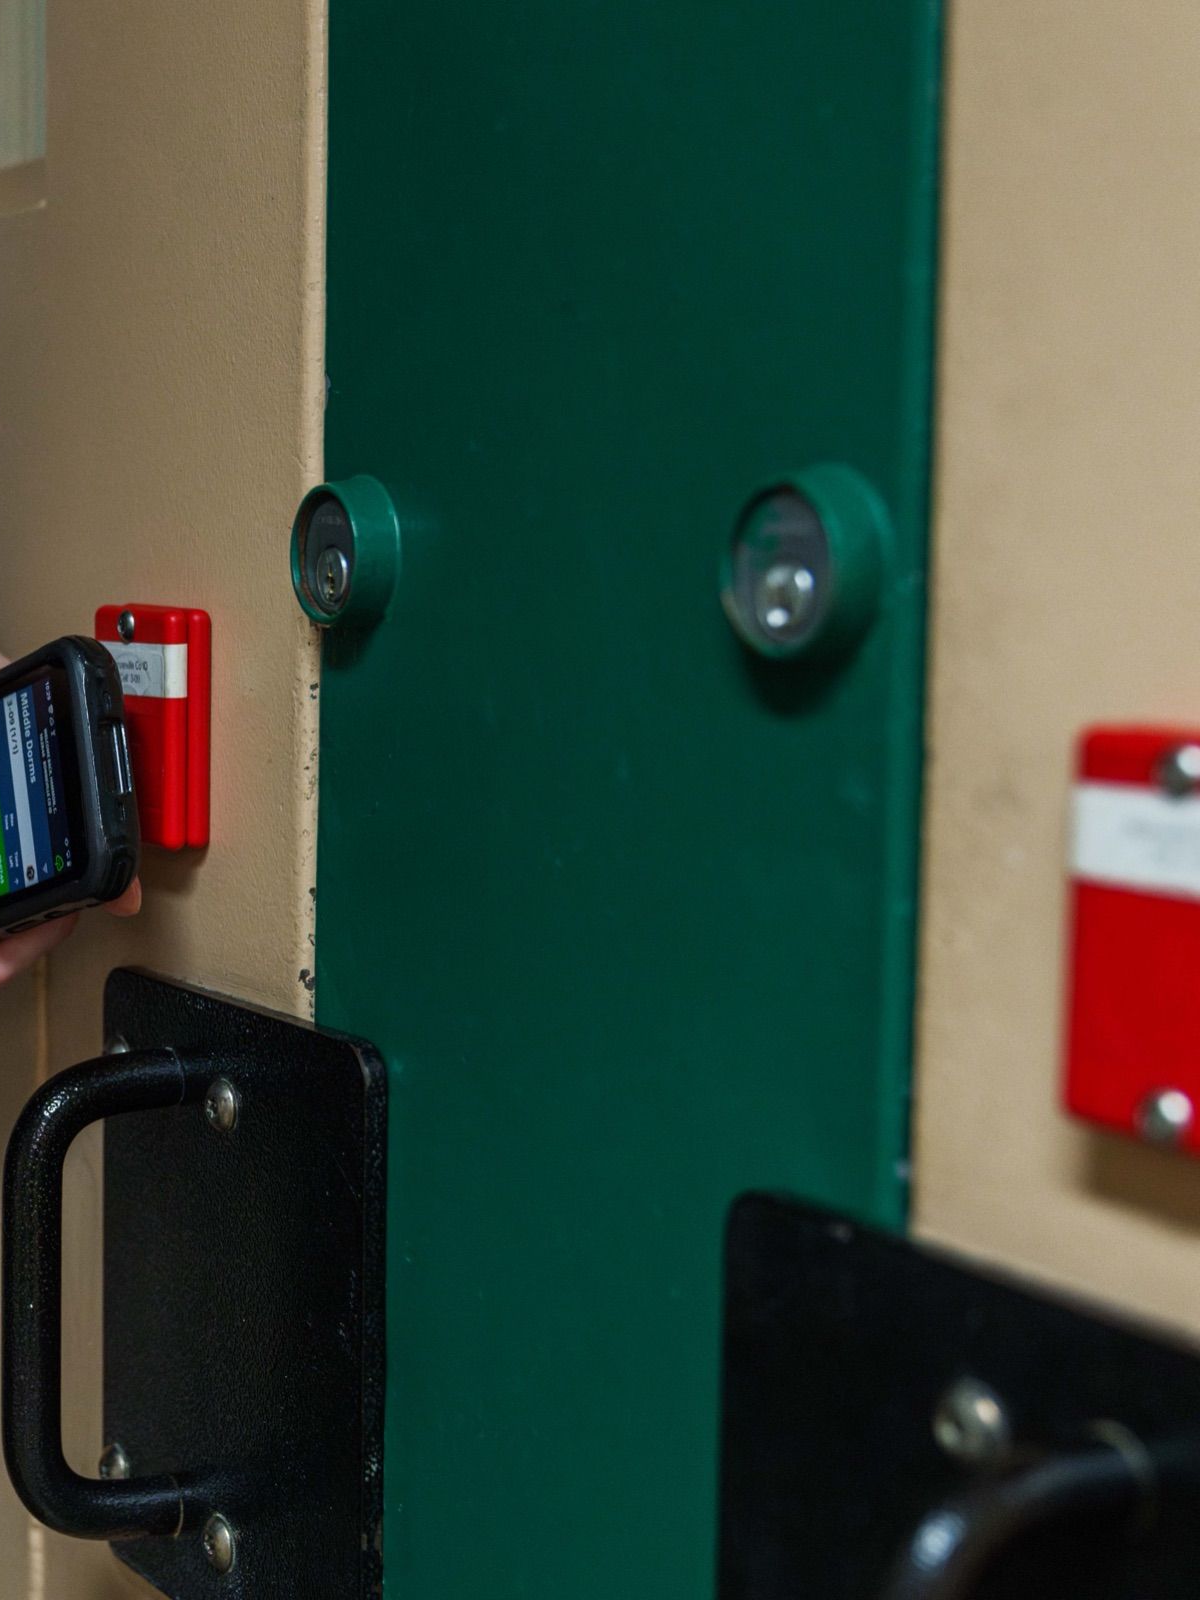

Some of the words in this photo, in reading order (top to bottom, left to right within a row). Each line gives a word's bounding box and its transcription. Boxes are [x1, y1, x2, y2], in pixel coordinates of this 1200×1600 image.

[6, 698, 15, 726] 3-09
[20, 690, 32, 738] Middle
[9, 726, 19, 756] (1/1)
[25, 738, 37, 784] Dorms
